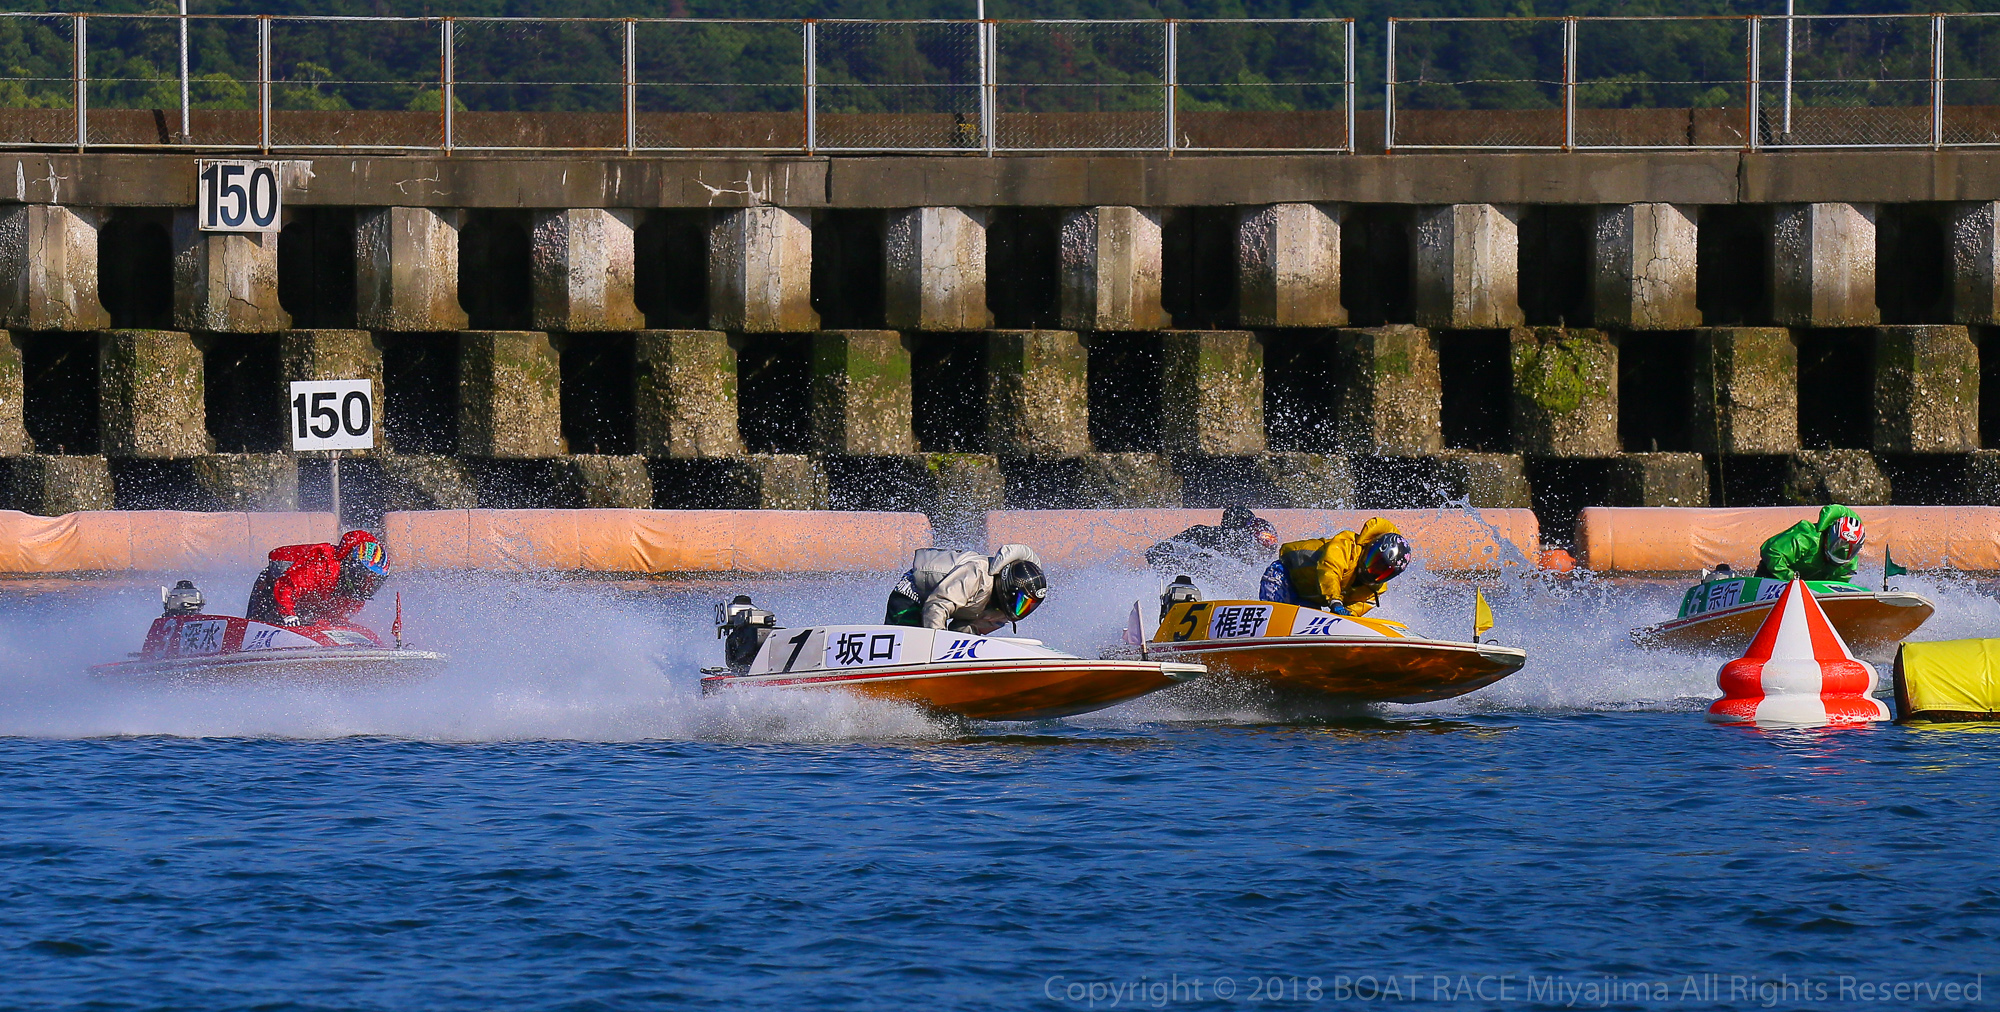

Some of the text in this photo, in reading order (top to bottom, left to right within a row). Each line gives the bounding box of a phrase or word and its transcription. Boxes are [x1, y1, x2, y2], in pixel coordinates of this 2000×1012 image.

[201, 164, 278, 228] 150
[292, 390, 371, 439] 150
[1687, 584, 1706, 615] 6
[1708, 582, 1740, 611] 宗行
[714, 602, 726, 625] 28
[1173, 603, 1206, 641] 5
[1215, 607, 1267, 638] 梶野
[183, 621, 221, 650] 深水
[782, 629, 813, 674] 1
[835, 632, 896, 666] 坂口
